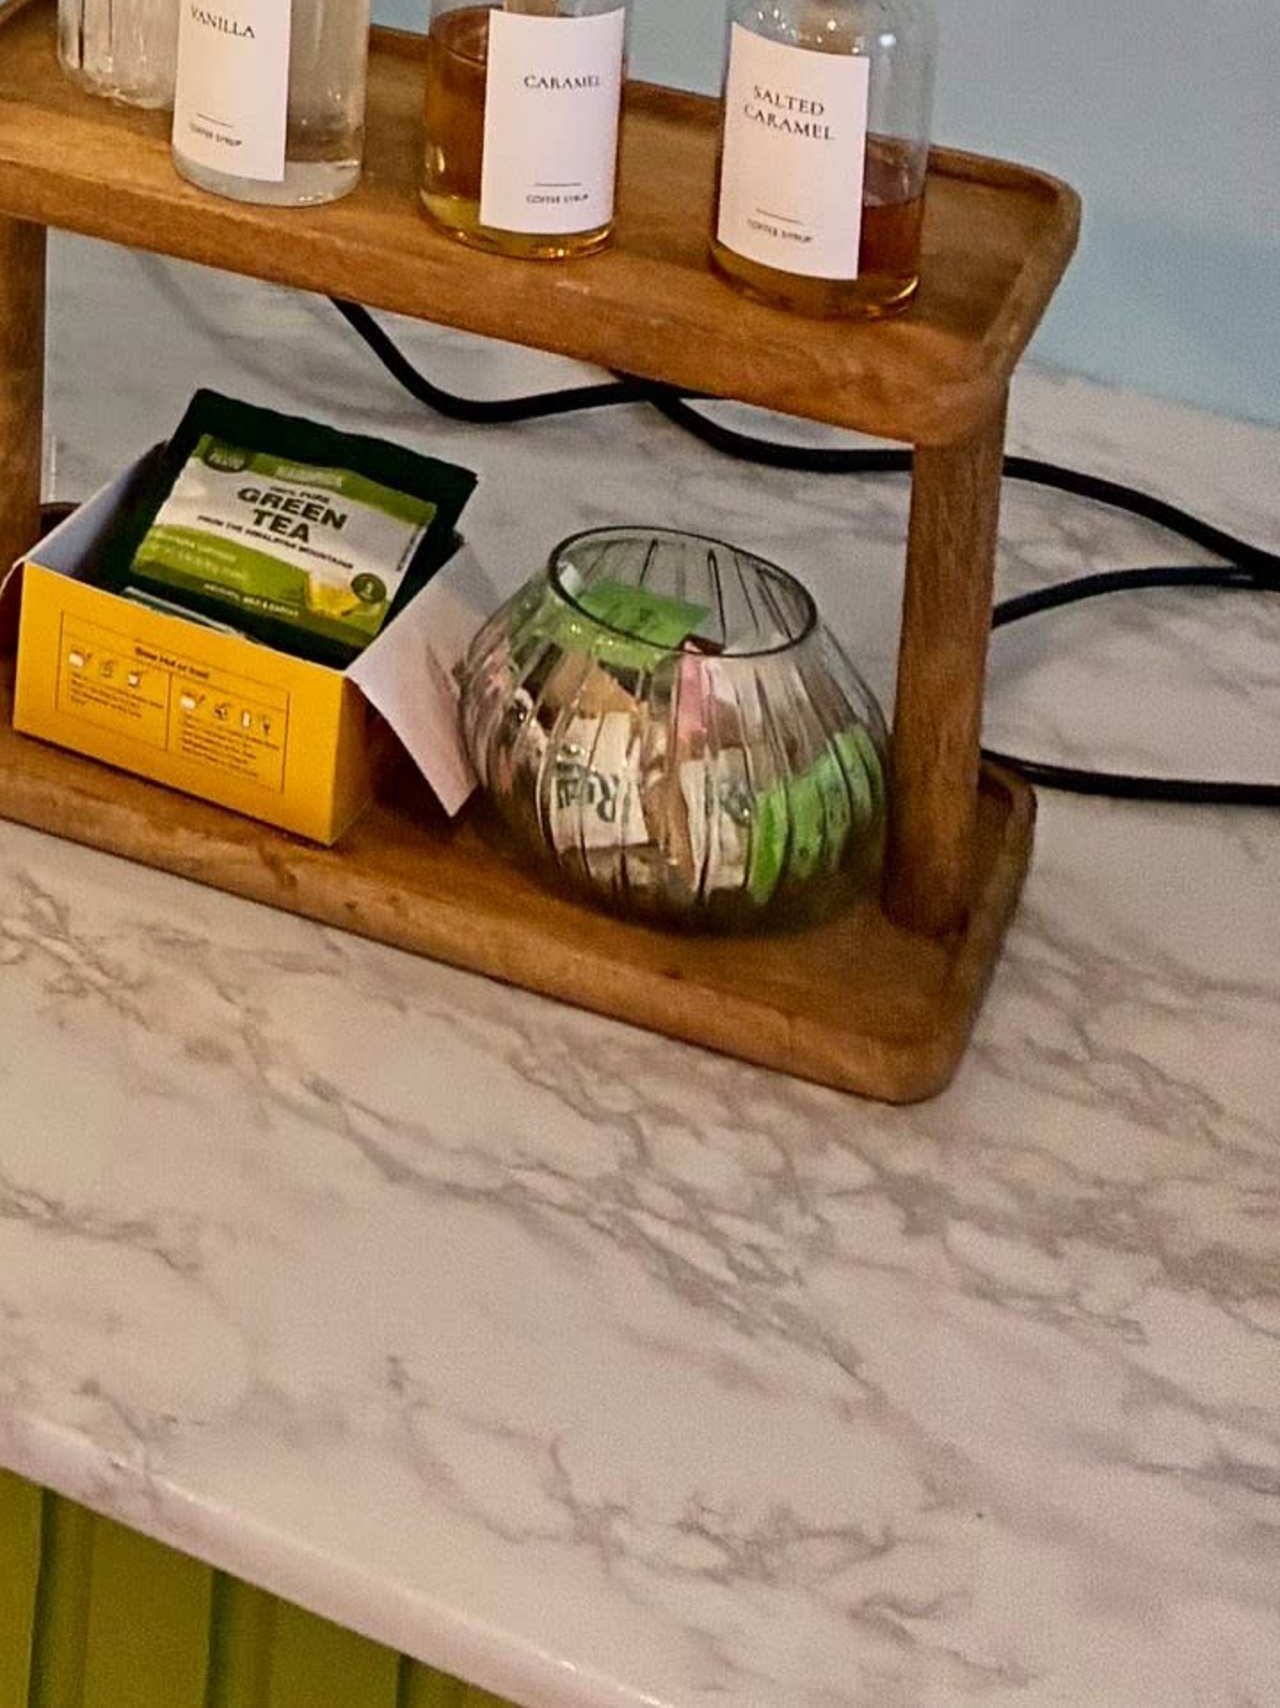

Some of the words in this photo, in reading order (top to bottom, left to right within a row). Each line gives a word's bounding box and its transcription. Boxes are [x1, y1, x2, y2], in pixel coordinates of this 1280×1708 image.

[190, 3, 256, 39] VANILLA
[523, 75, 600, 89] CARAMEL
[753, 84, 825, 116] SALTED
[743, 103, 836, 140] CARAMEL
[237, 486, 349, 531] GREEN
[251, 508, 310, 544] TEA
